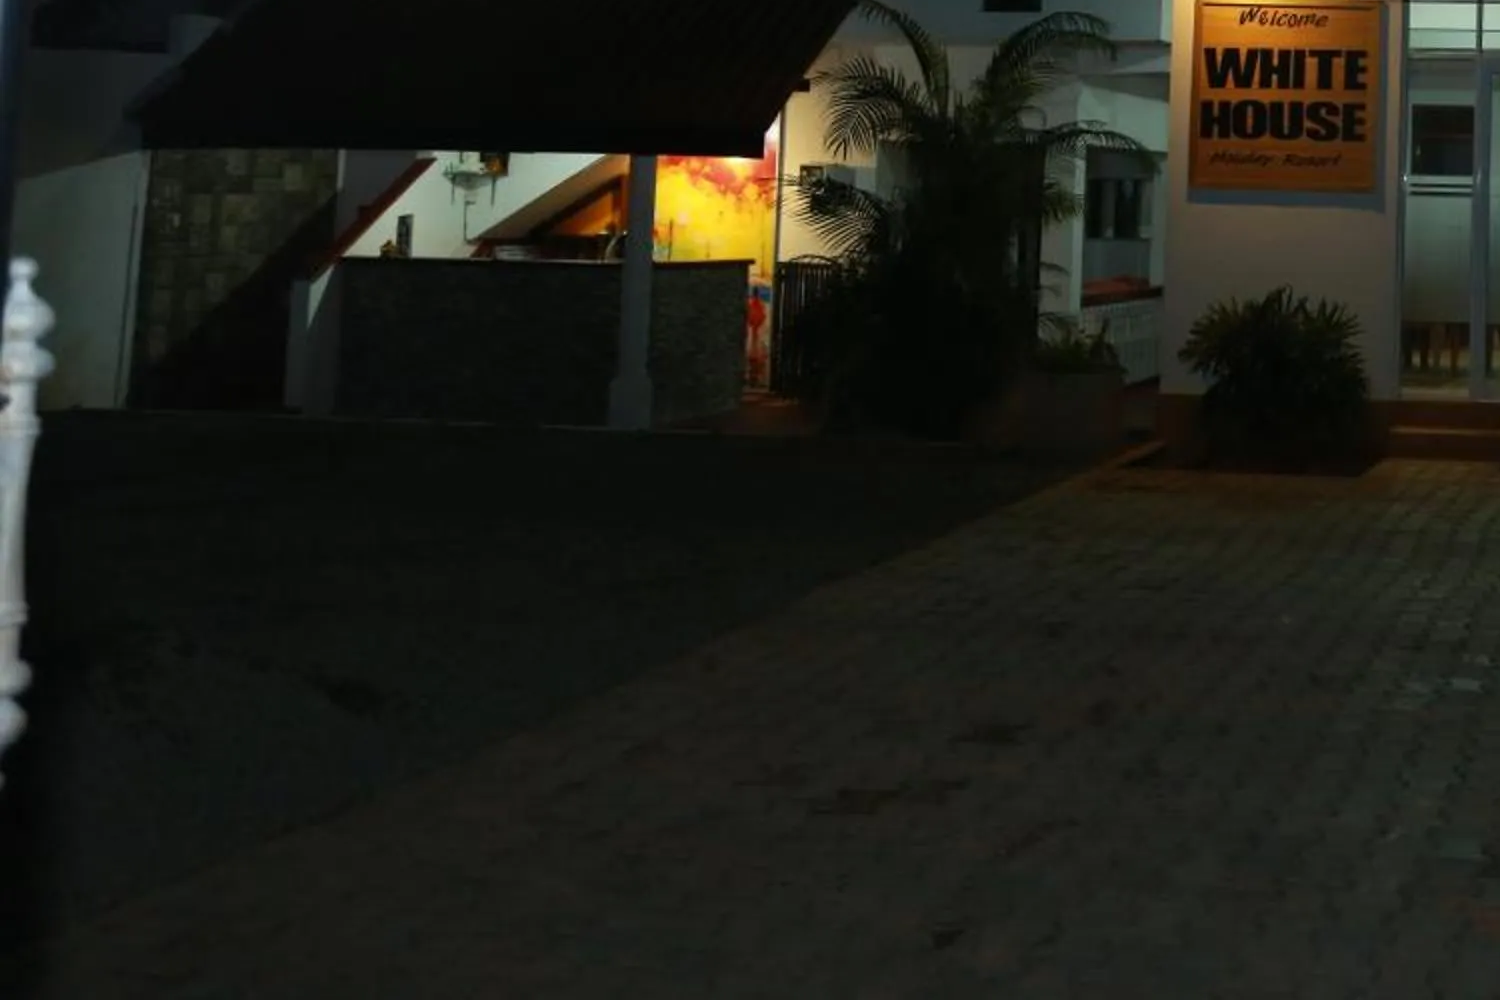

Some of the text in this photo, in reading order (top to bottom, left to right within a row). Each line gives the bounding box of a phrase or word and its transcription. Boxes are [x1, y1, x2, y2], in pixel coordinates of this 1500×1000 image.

[1239, 7, 1329, 28] Welcome
[1204, 47, 1368, 91] WHITE
[1200, 99, 1366, 143] HOUSE
